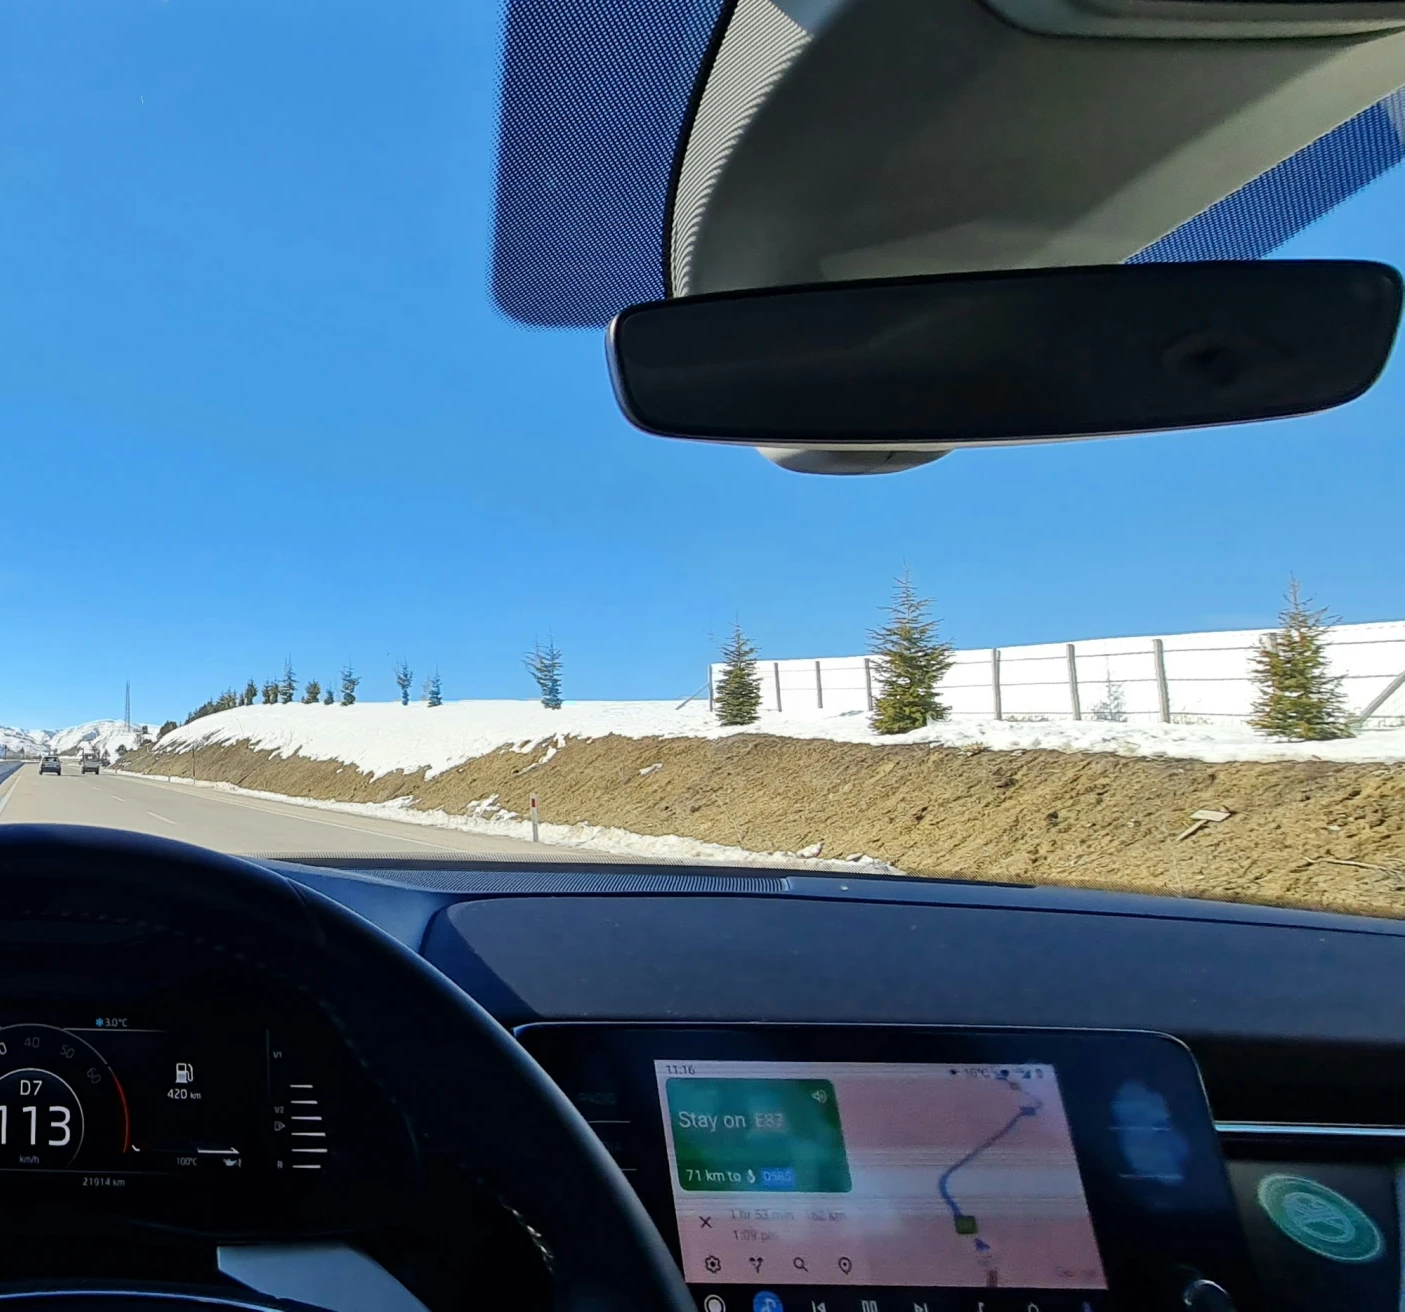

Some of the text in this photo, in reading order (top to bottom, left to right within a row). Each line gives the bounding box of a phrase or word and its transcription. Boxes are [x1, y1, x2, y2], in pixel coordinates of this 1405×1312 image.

[24, 1036, 40, 1049] 40
[60, 1044, 75, 1059] 50
[86, 1067, 102, 1084] 60
[665, 1064, 696, 1076] 11:16
[20, 1079, 43, 1096] D7
[167, 1088, 201, 1099] 420 km
[678, 1111, 783, 1132] Stay on E87
[19, 1154, 40, 1164] km/h
[685, 1168, 702, 1182] 71
[705, 1168, 725, 1182] km
[728, 1169, 742, 1182] to
[112, 1177, 125, 1187] km
